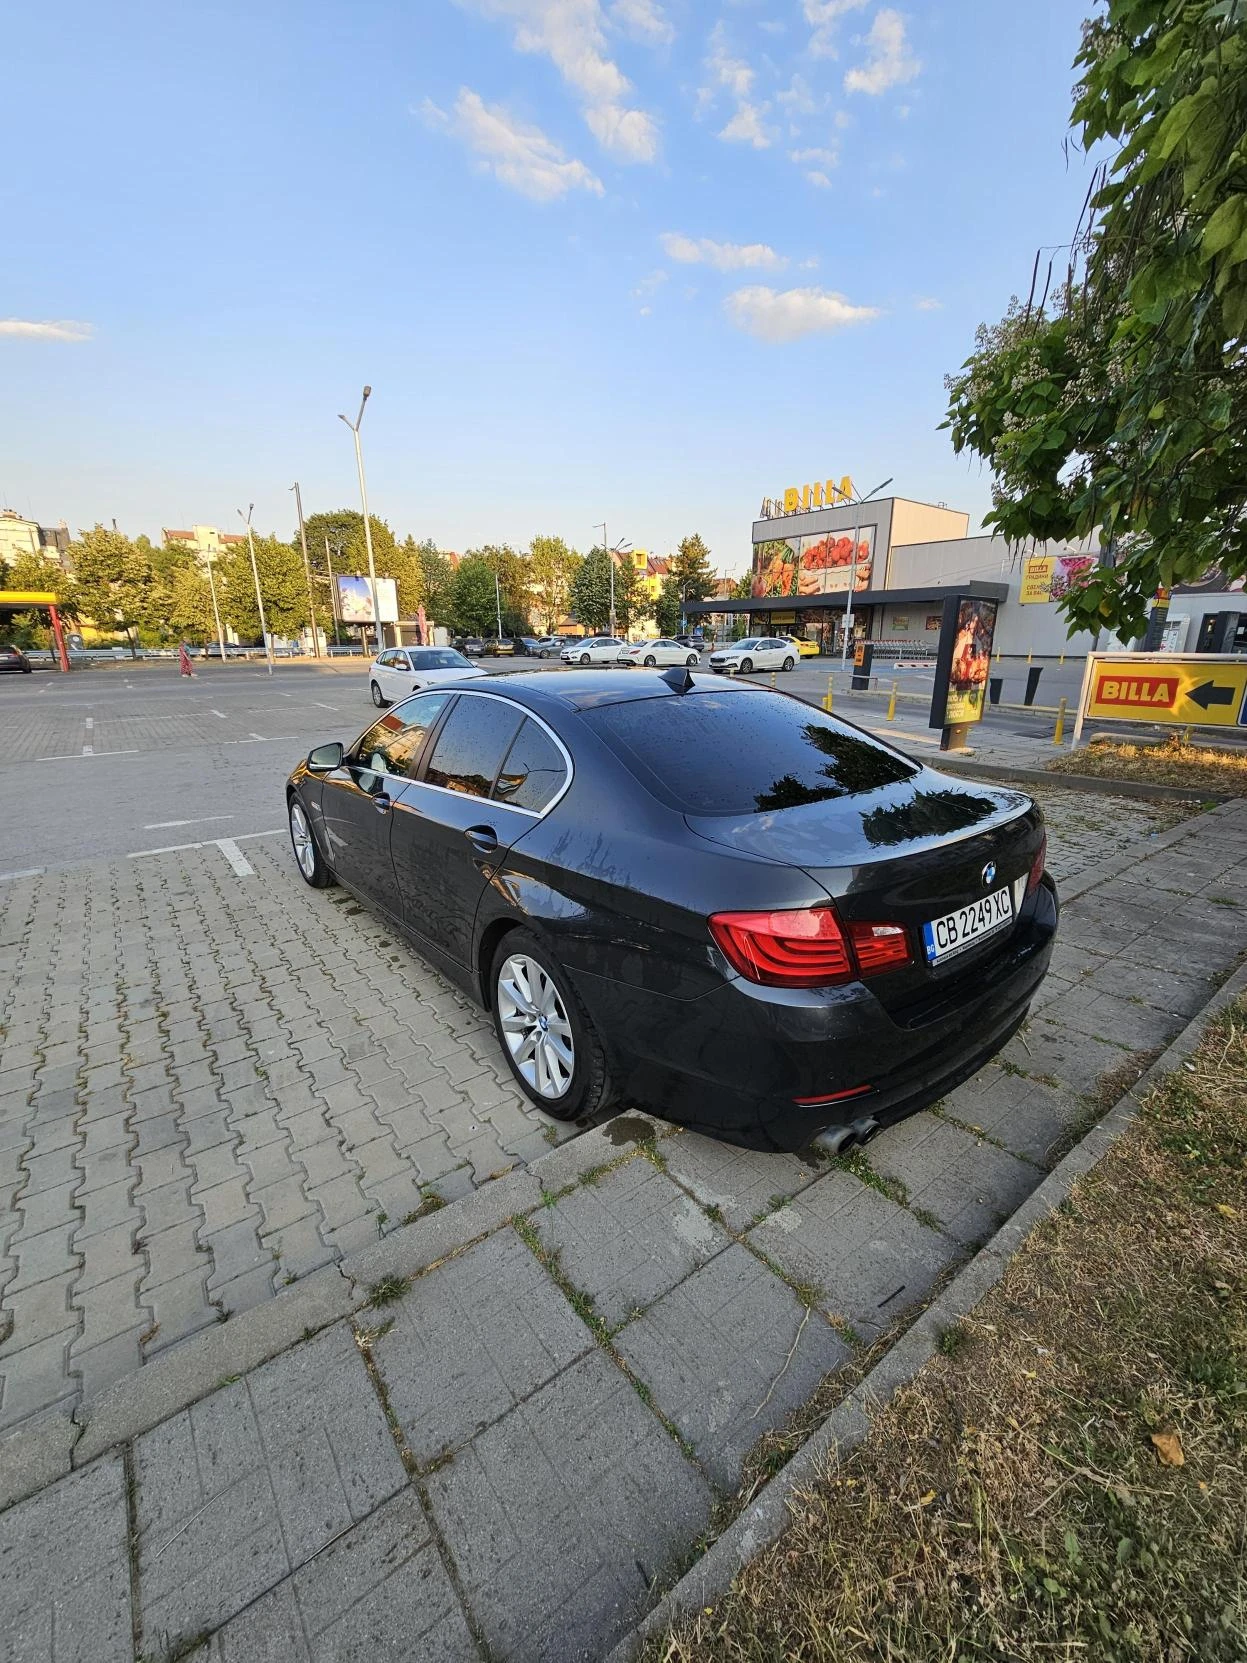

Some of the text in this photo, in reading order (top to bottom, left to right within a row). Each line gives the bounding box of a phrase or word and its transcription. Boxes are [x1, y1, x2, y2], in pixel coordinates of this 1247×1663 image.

[784, 476, 852, 512] BILLA
[1101, 681, 1170, 703] BILLA
[936, 916, 958, 949] CB
[960, 898, 992, 938] 2249
[993, 890, 1010, 920] XC
[926, 944, 935, 955] BG
